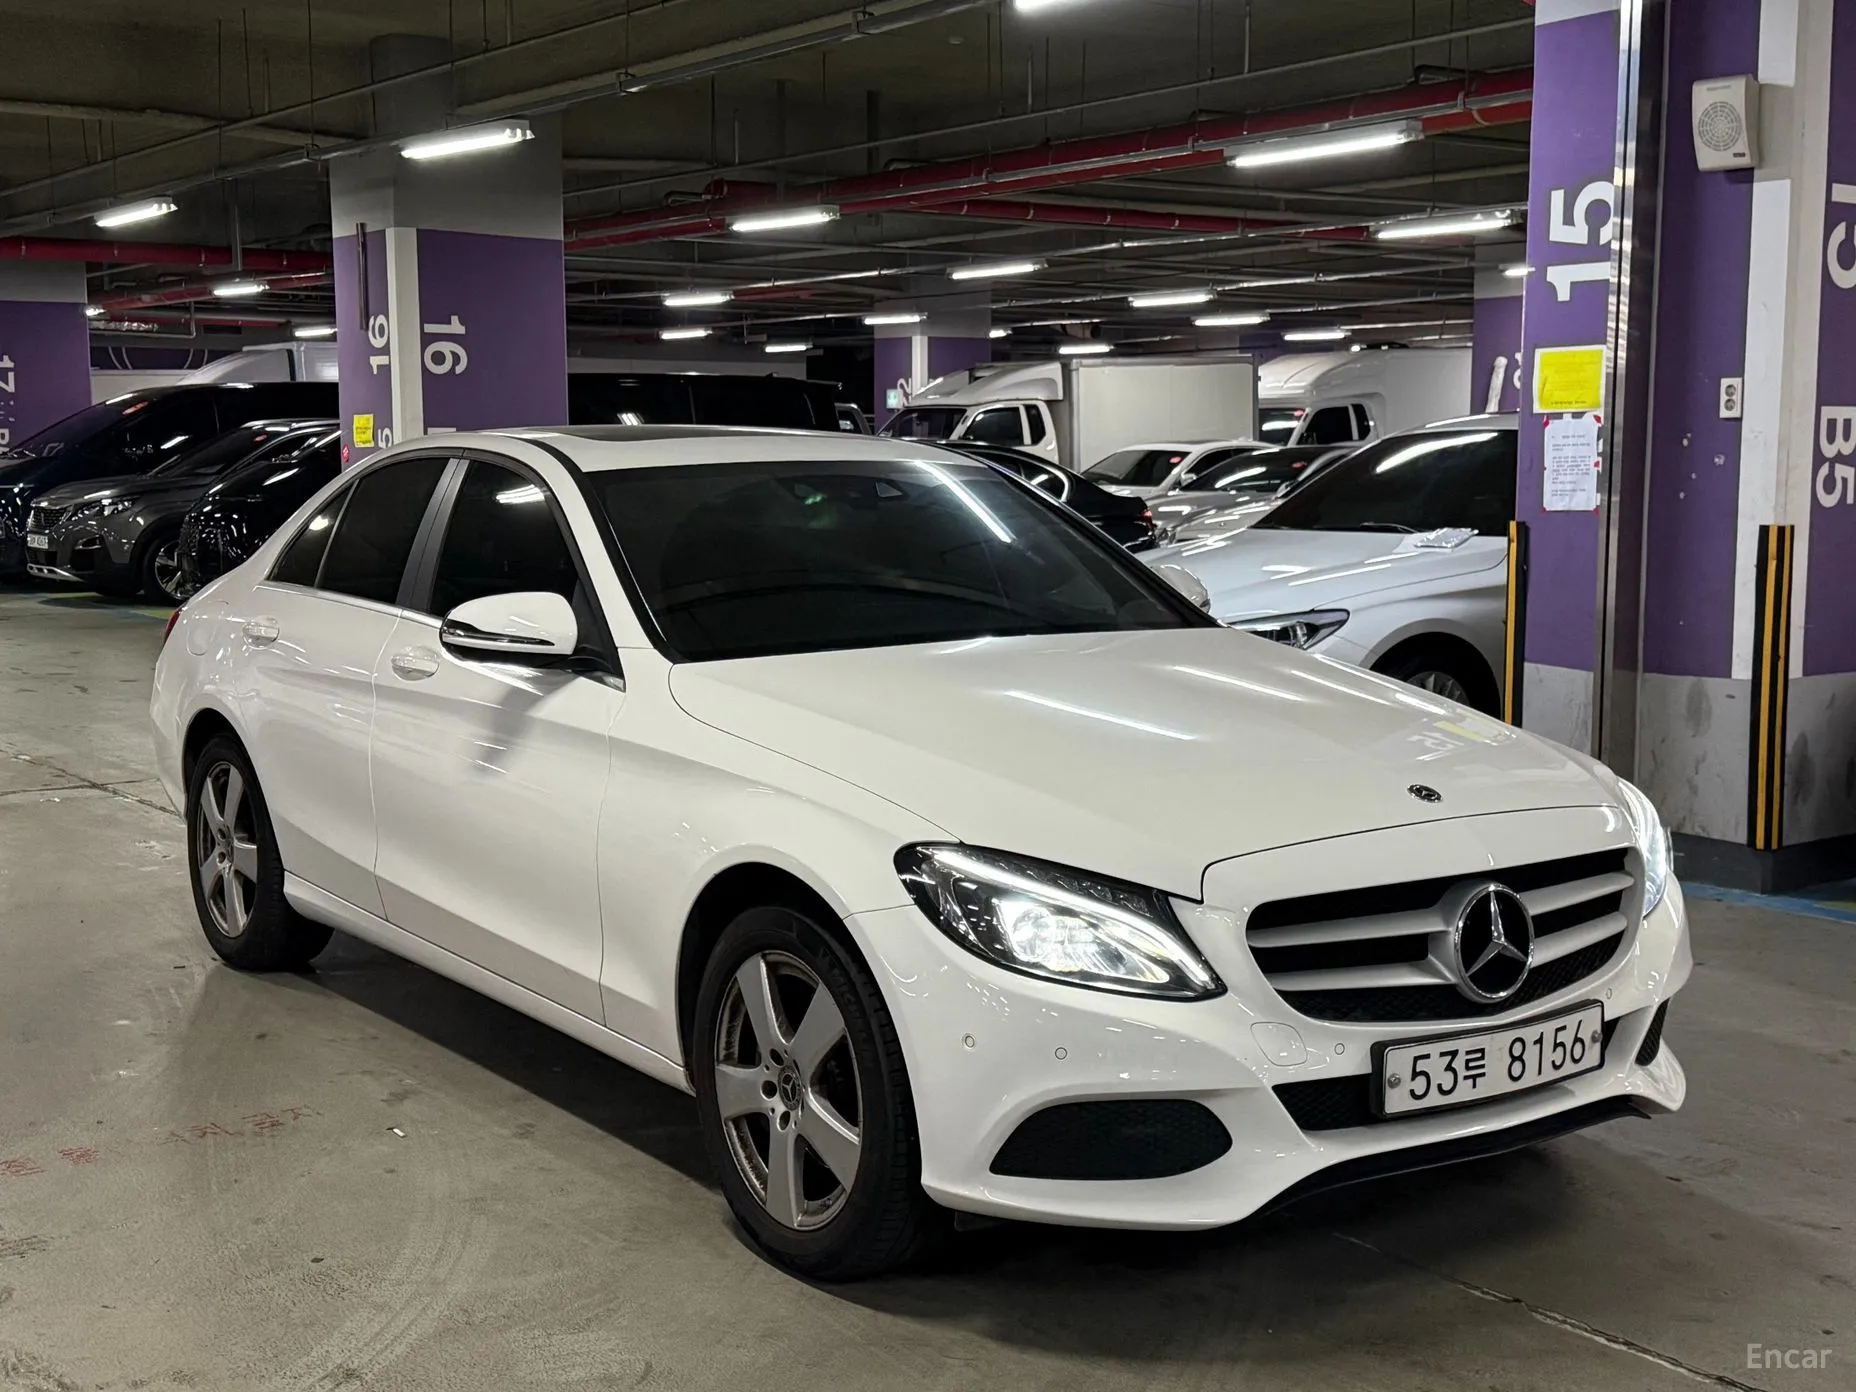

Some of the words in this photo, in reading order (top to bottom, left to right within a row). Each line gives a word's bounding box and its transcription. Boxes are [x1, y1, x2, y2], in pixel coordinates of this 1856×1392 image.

[1546, 181, 1614, 301] 15
[368, 314, 390, 374] 16
[423, 315, 468, 374] 16
[1816, 406, 1856, 509] B5
[1409, 1047, 1486, 1101] 53루
[1507, 1019, 1586, 1082] 8156
